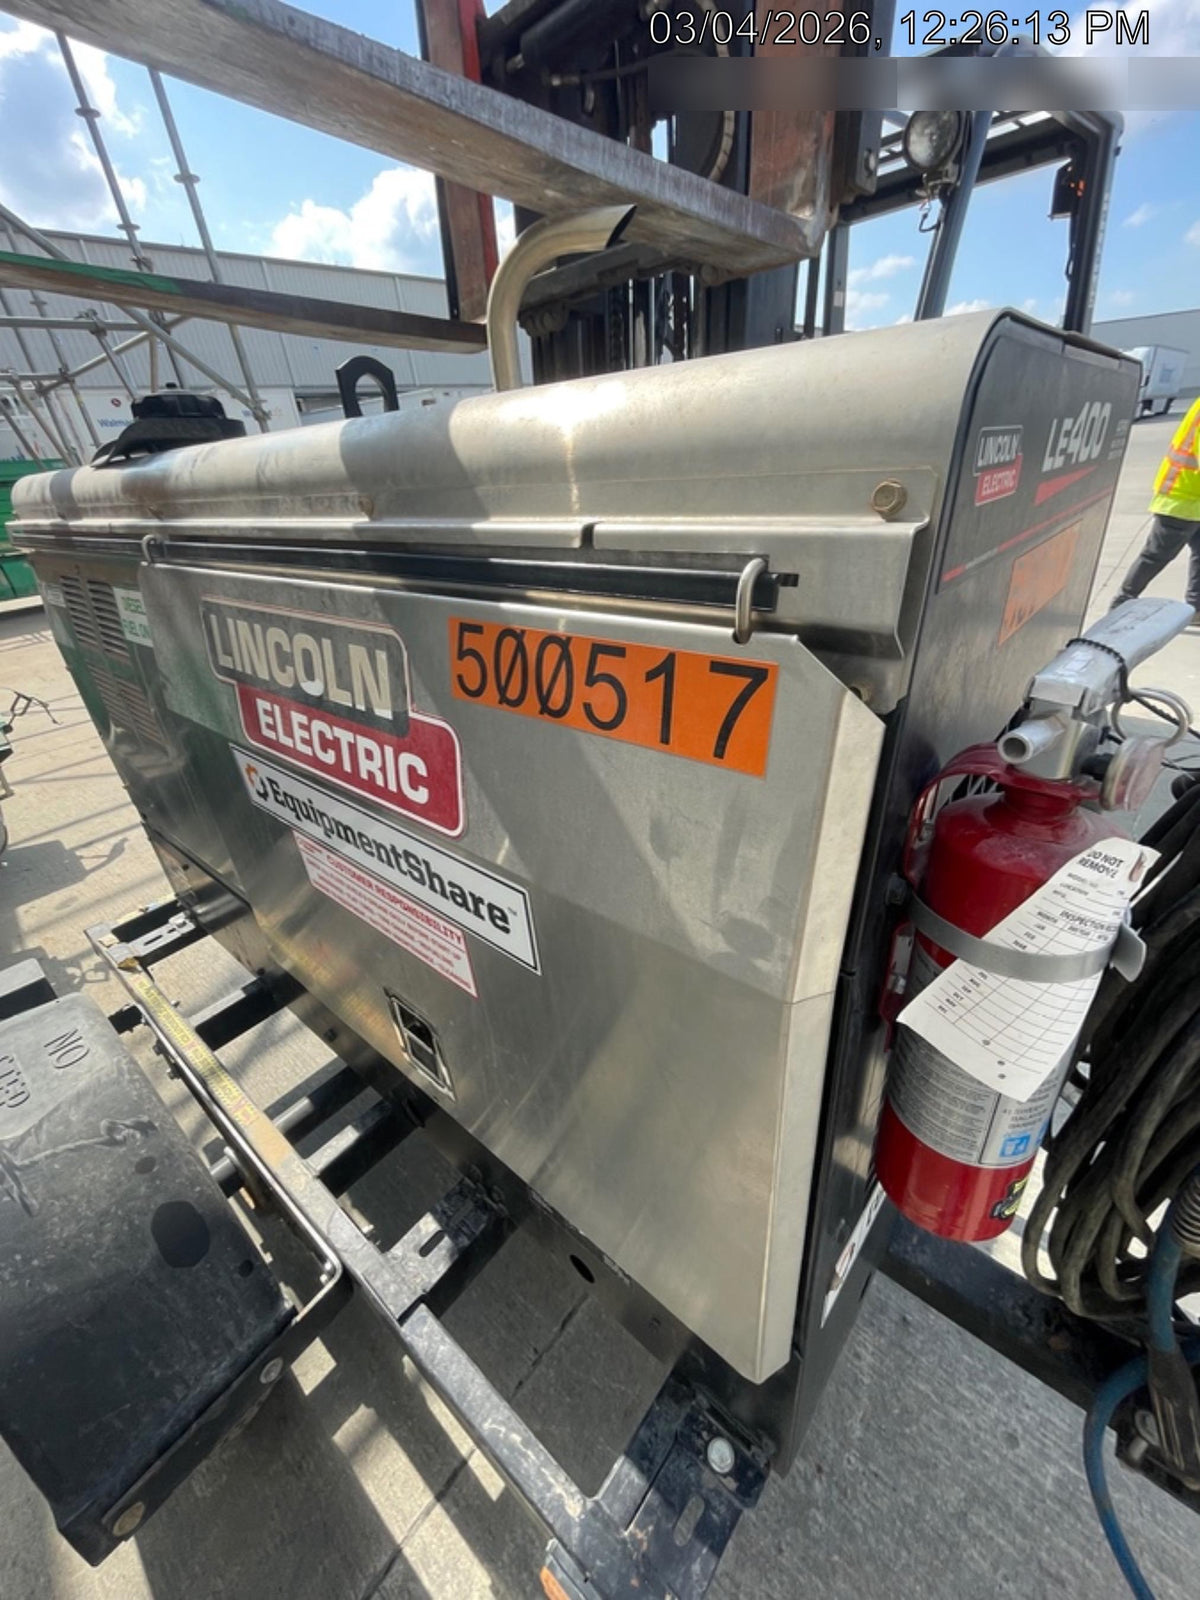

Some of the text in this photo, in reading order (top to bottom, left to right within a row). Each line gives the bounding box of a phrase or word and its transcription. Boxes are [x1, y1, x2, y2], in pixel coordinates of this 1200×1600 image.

[977, 434, 1021, 469] LINCOLN
[1041, 401, 1113, 473] LE400
[981, 468, 1017, 497] ELECTRIC
[210, 613, 393, 721] LINCOLN
[456, 622, 769, 760] 500517
[256, 698, 430, 805] ELECTRIC
[268, 777, 511, 934] EquipmentShare
[43, 1028, 91, 1070] NO
